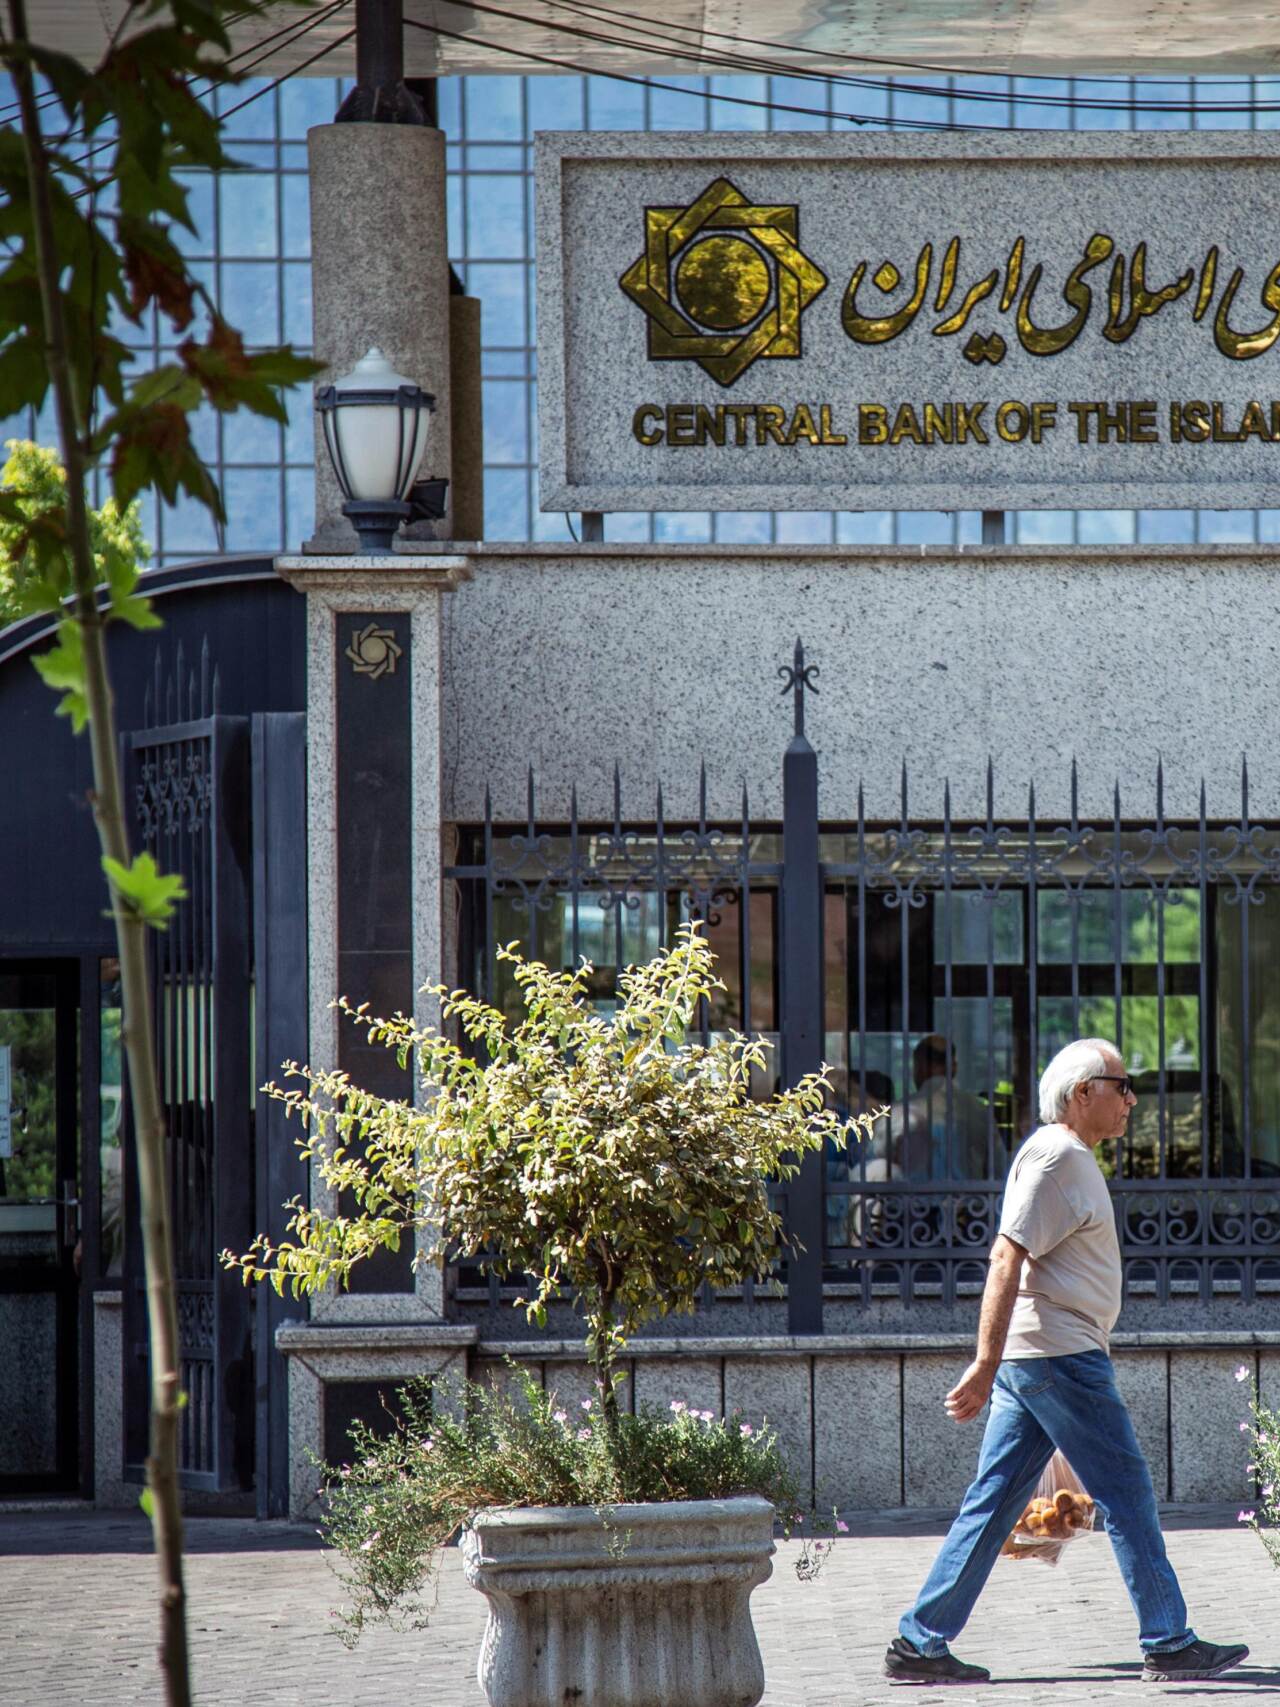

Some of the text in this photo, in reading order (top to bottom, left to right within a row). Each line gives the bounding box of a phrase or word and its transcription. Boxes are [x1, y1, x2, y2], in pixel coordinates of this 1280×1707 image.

[841, 235, 1025, 364] ایران
[1015, 233, 1219, 356] اسلامی
[632, 402, 848, 447] CENTRAL
[857, 401, 990, 446] BANK
[997, 400, 1057, 444] OF
[1068, 399, 1160, 443] THE
